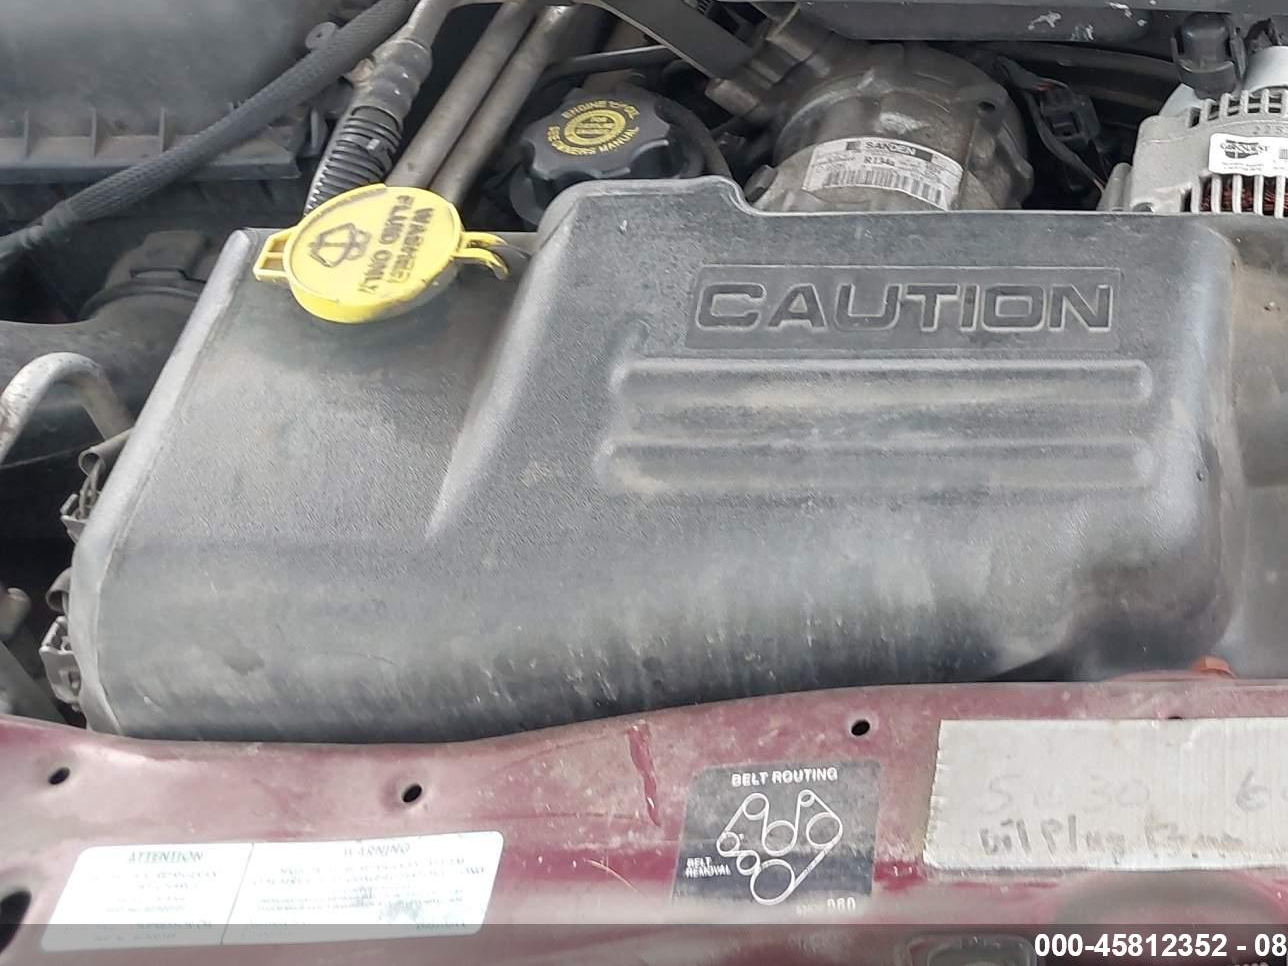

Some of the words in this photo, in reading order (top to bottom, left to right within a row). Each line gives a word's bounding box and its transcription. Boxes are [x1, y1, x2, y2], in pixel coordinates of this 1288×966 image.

[866, 140, 917, 156] SANDEN
[379, 194, 415, 245] FLUID
[388, 206, 435, 284] WASHER
[357, 249, 393, 294] ONLY
[696, 282, 1115, 332] CAUTION
[731, 770, 769, 787] BELT
[771, 766, 839, 784] ROUTING
[128, 850, 205, 864] ATTENTION
[343, 843, 412, 857] WARNING
[686, 856, 712, 867] BELT
